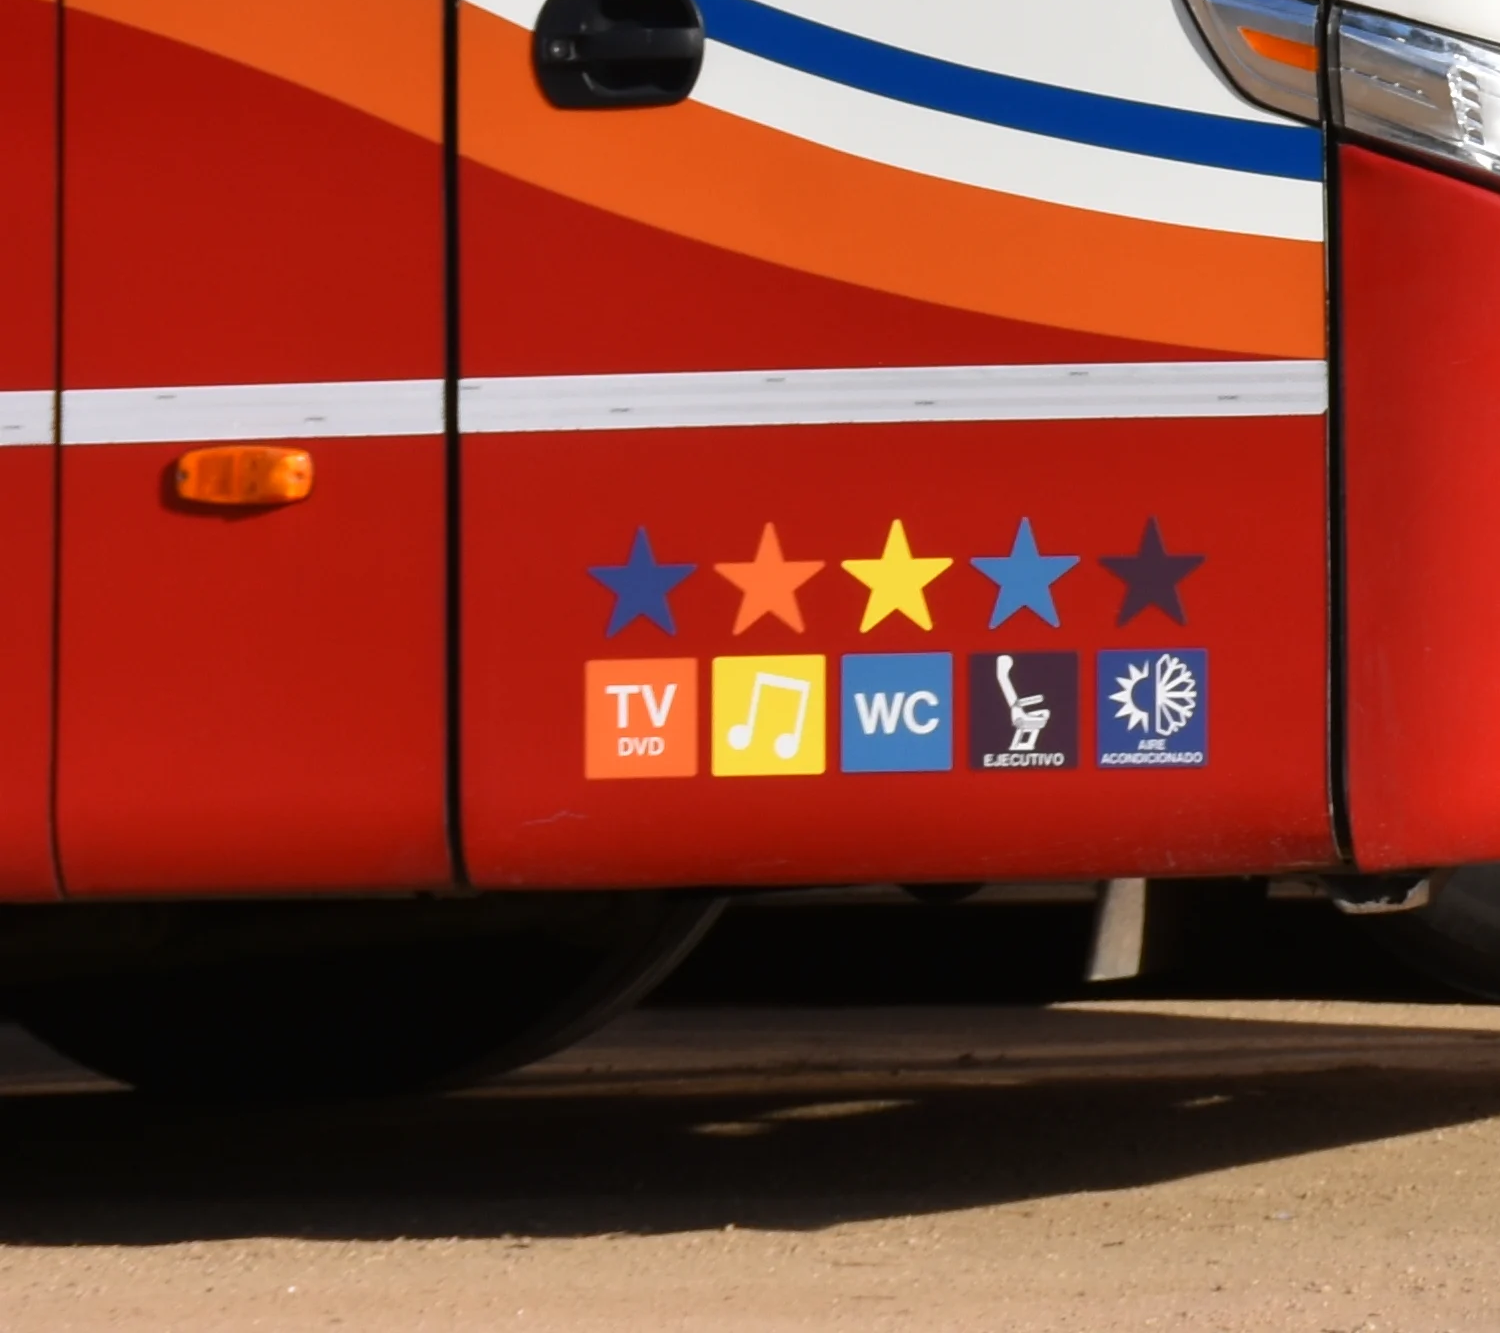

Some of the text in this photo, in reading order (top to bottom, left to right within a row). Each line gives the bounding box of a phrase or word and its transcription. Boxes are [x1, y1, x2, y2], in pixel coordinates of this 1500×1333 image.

[605, 682, 678, 728] TV
[853, 690, 940, 736] WC
[616, 735, 666, 757] DVD
[982, 751, 1066, 768] EJECUTIVO
